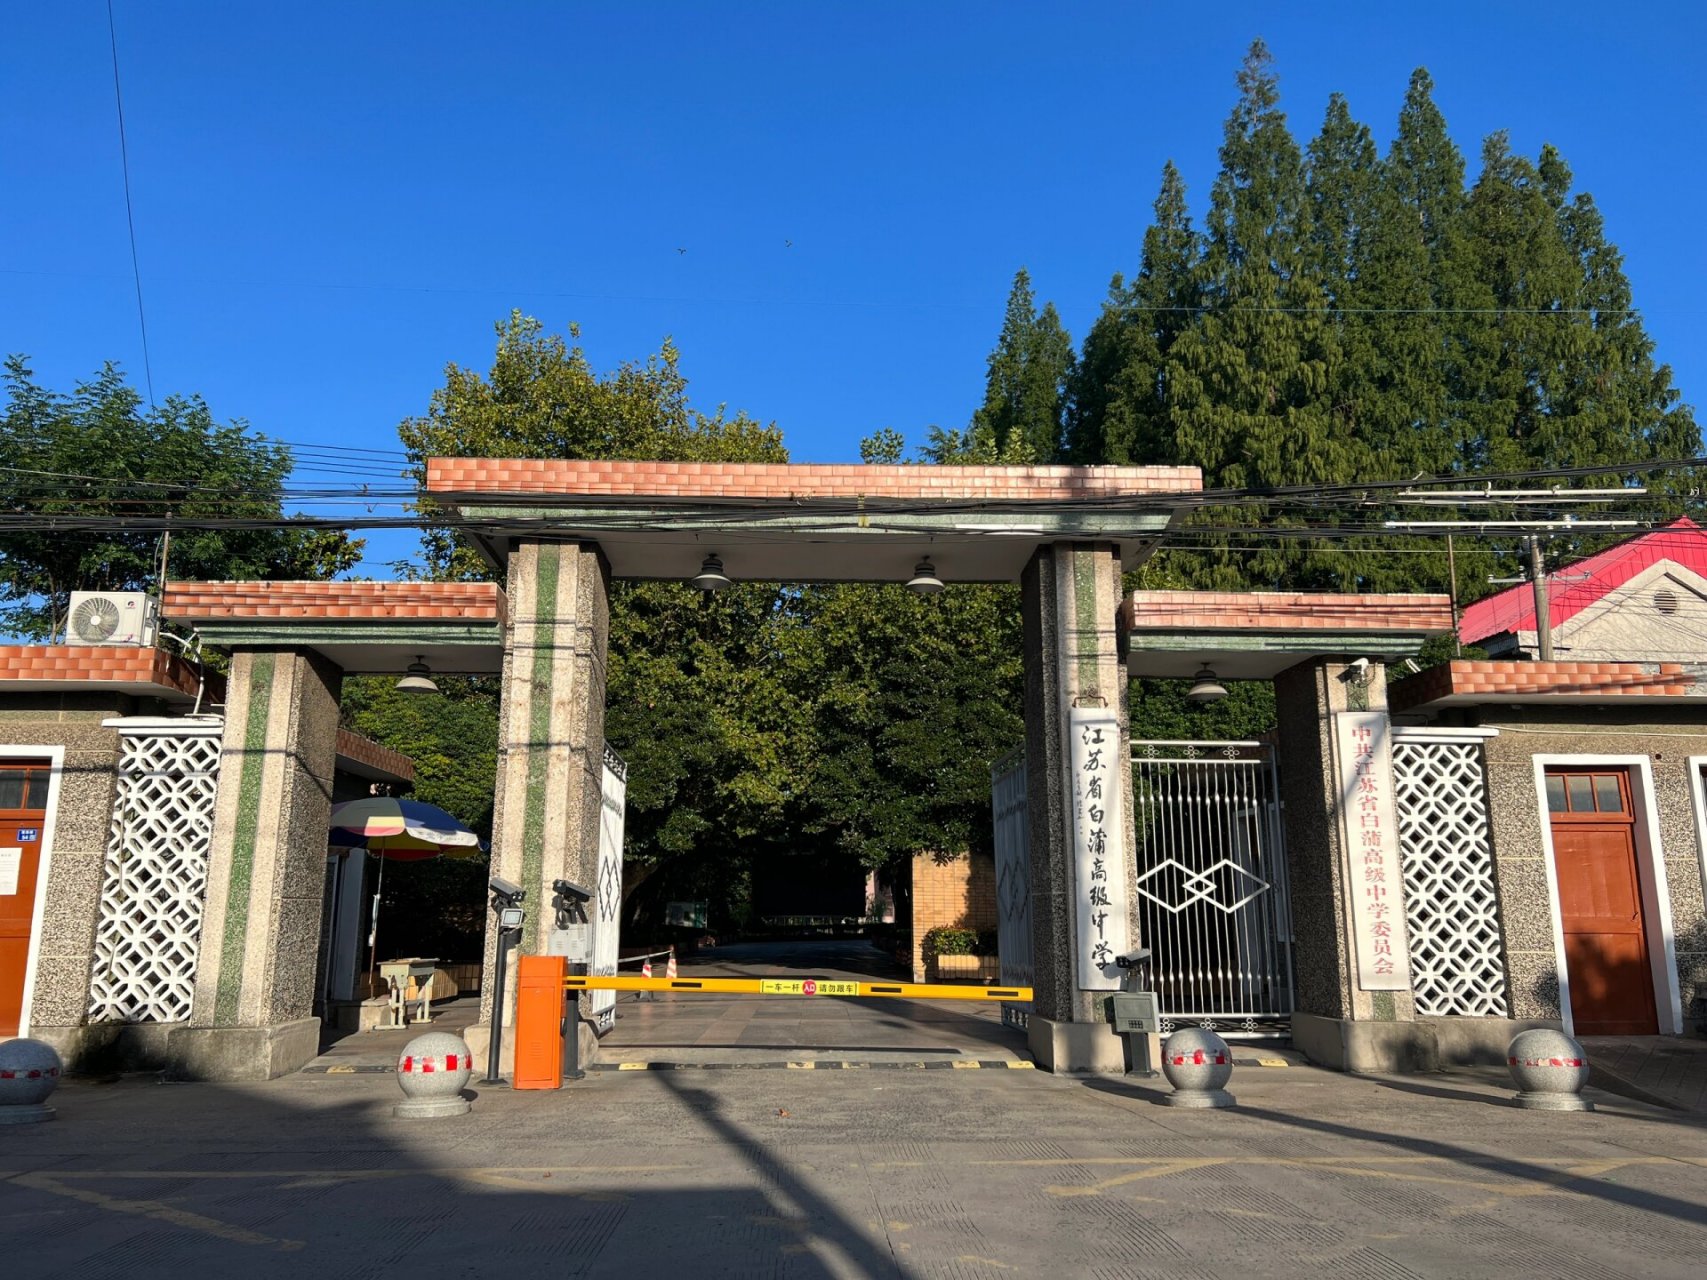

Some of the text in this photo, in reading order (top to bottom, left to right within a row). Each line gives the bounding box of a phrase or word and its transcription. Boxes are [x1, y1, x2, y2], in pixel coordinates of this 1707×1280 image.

[1082, 725, 1113, 970] 江苏省白蒲高级中学
[1352, 726, 1394, 975] 中共江苏省白蒲高级中学委员会
[765, 983, 800, 992] 一车一杆
[819, 983, 854, 993] 请勿跟车
